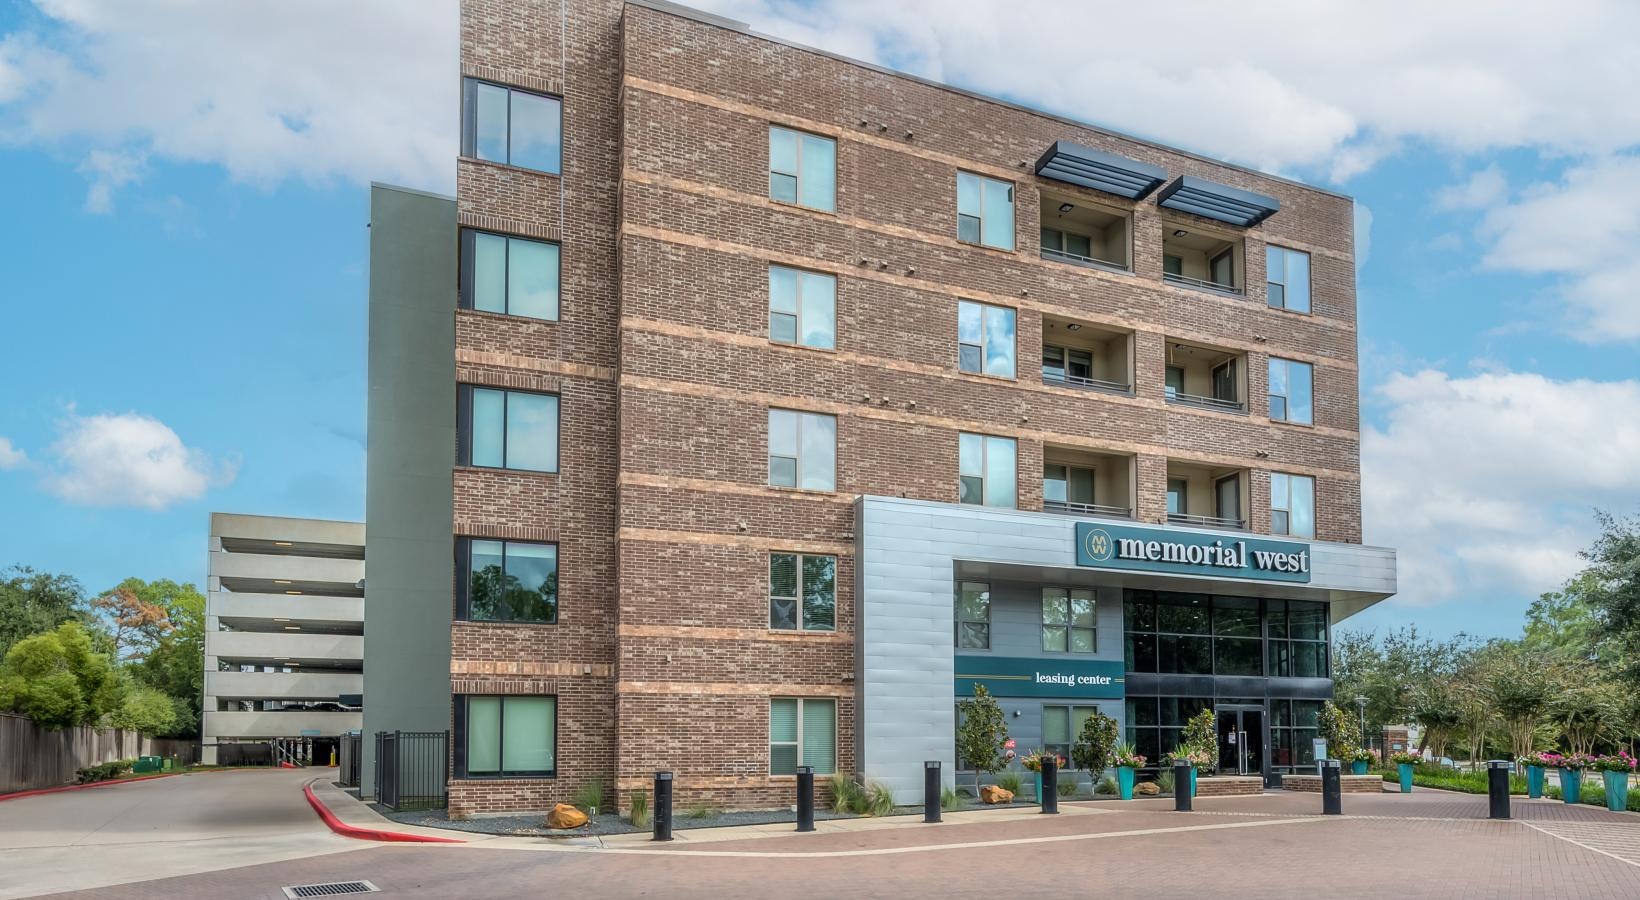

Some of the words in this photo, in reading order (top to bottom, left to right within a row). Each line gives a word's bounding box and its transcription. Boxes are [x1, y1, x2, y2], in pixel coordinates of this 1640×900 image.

[1118, 538, 1248, 568] memorial
[1254, 549, 1309, 573] west
[1036, 672, 1075, 686] leasing
[1077, 674, 1111, 685] center
